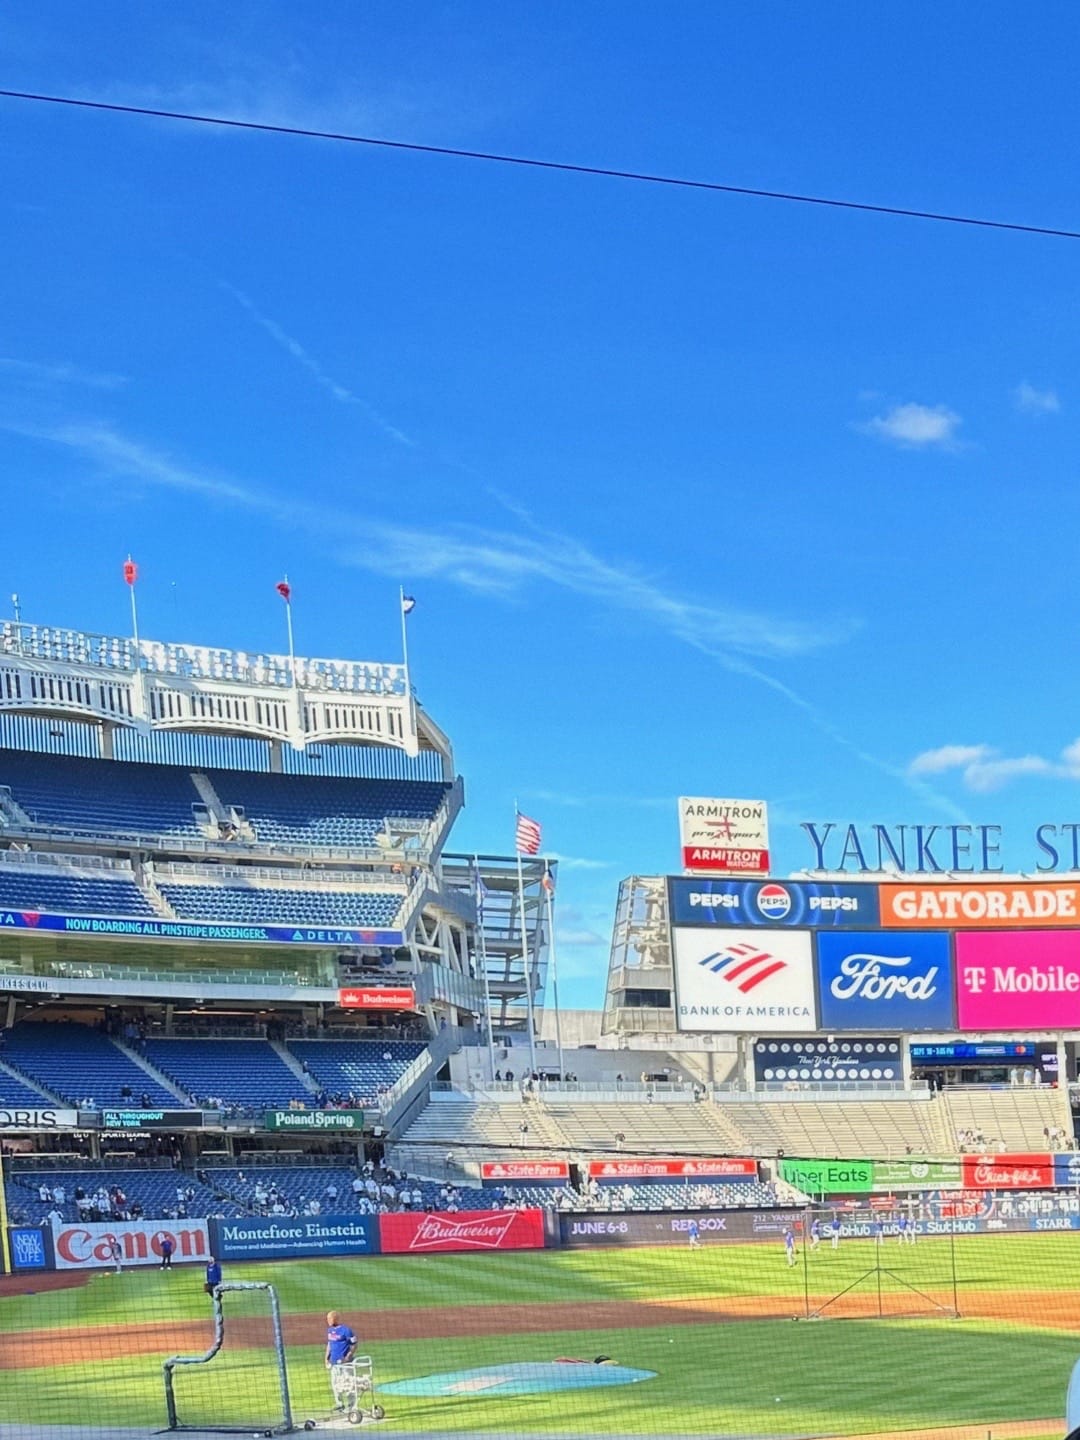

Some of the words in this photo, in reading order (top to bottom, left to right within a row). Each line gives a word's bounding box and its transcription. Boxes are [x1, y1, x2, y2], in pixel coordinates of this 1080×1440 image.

[685, 805, 762, 819] ARMITRON
[800, 822, 1004, 873] YANKEE
[692, 849, 761, 862] ARMITRON
[726, 860, 760, 868] WATCHES
[689, 893, 739, 908] PEPSI
[760, 897, 788, 906] PEPSI
[809, 896, 858, 911] PEPSI
[892, 889, 1077, 920] GATORADE
[66, 918, 90, 931] NOW
[92, 919, 142, 934] BOARDING
[143, 921, 160, 935] ALL
[161, 922, 208, 937] PINSTRIPE
[209, 926, 269, 940] PASSENGERS.
[307, 931, 353, 942] DELTA
[830, 954, 939, 1000] Ford
[992, 966, 1080, 993] Mobile
[363, 994, 411, 1005] Budweiser
[680, 1005, 720, 1016] BANK
[724, 1006, 742, 1017] OF
[746, 1006, 810, 1018] AMERICA
[275, 1111, 315, 1127] Poland
[315, 1112, 355, 1128] Spring
[828, 1168, 868, 1182] Eats
[571, 1221, 606, 1236] JUNE
[607, 1220, 628, 1234] 6-8
[671, 1218, 697, 1232] RED
[698, 1217, 728, 1231] SOX
[1036, 1217, 1072, 1229] STARR
[223, 1223, 303, 1242] Montefiore
[305, 1222, 365, 1238] Einstein
[417, 1222, 507, 1240] Budweiser
[16, 1234, 38, 1245] NEW
[56, 1229, 207, 1263] Canon
[346, 1238, 366, 1247] Health
[15, 1242, 42, 1254] YORK
[18, 1252, 41, 1263] LIFE
